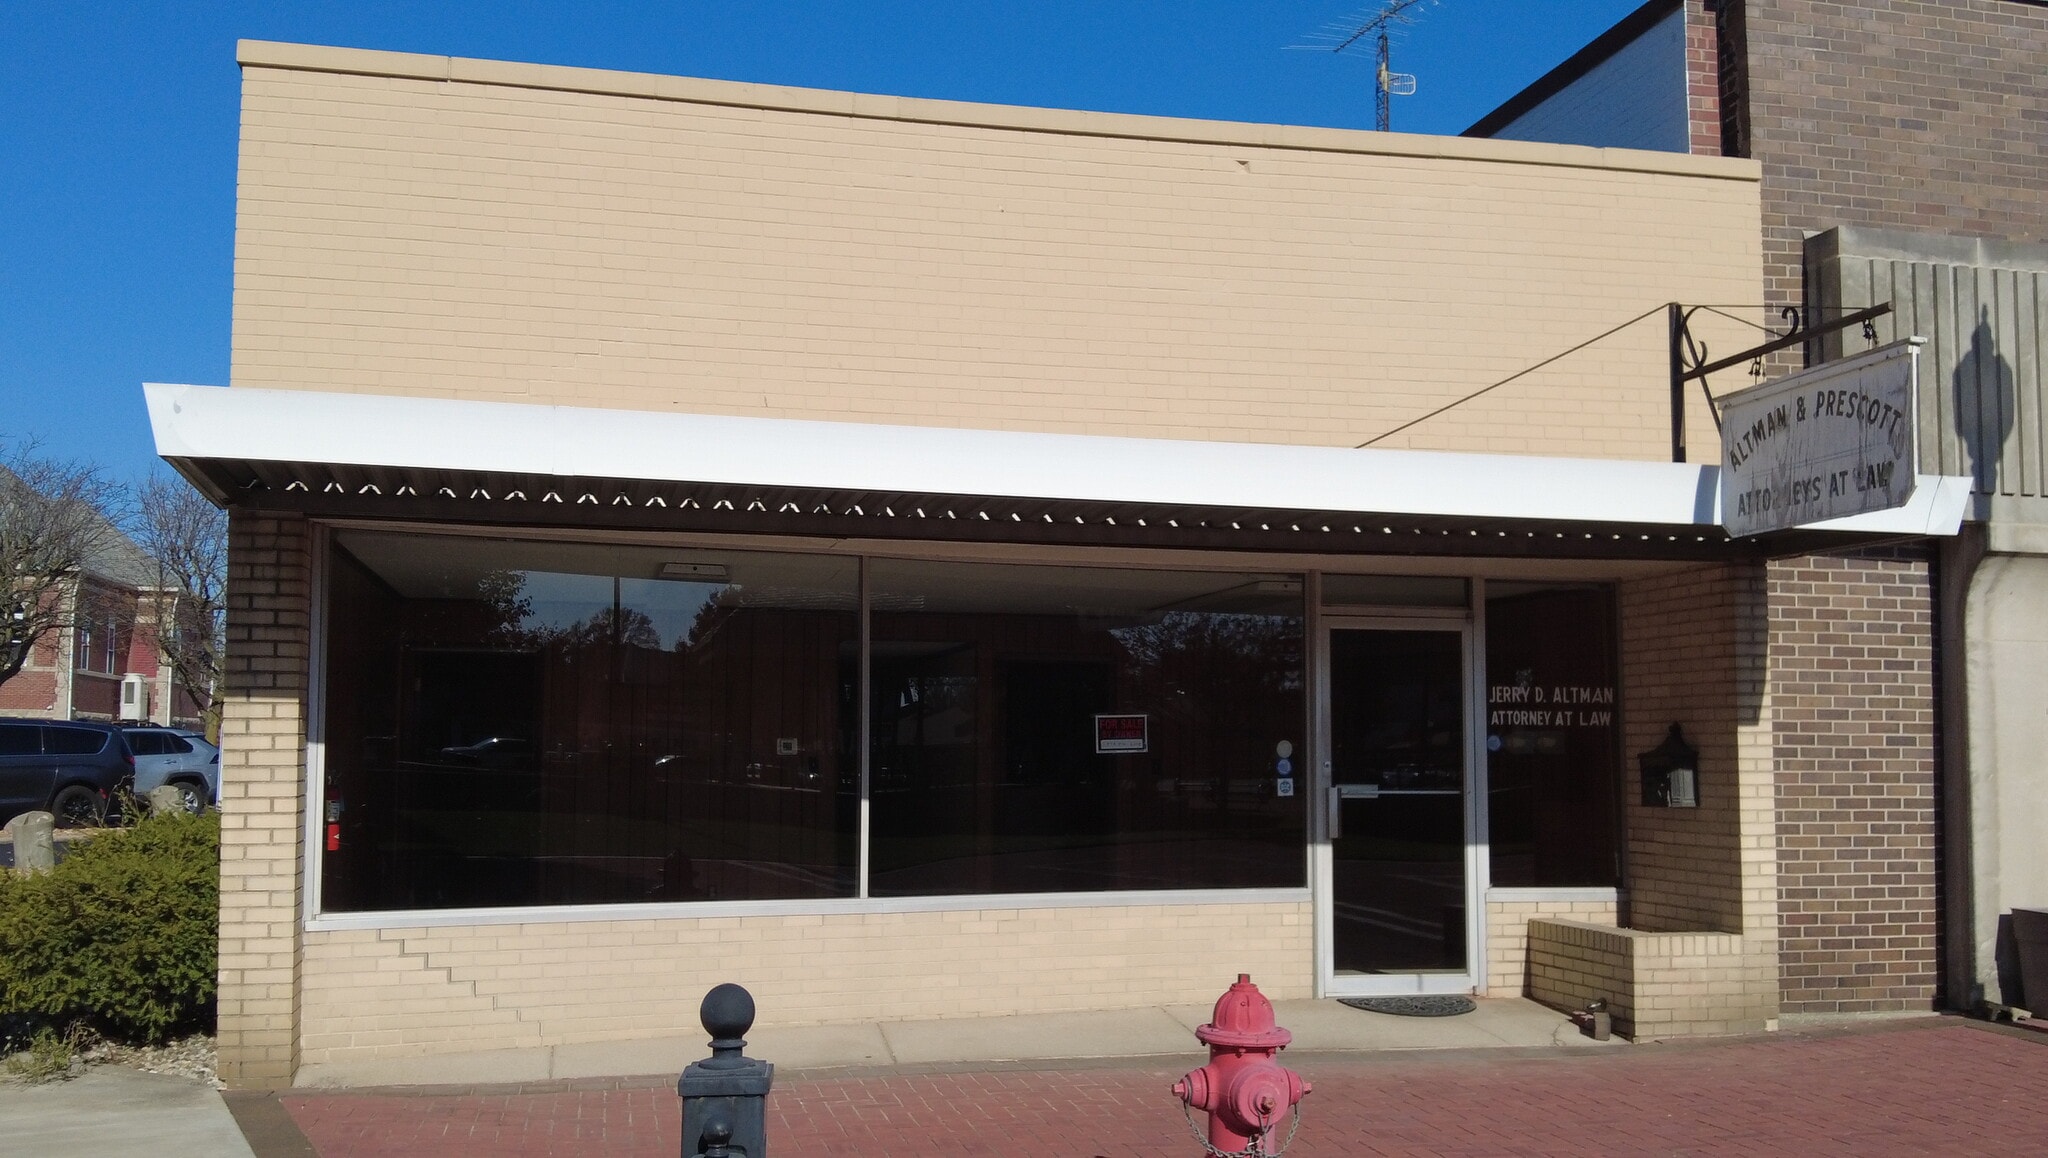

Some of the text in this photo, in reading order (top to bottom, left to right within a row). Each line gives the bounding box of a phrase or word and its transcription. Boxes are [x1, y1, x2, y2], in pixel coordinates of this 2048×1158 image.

[1730, 390, 1902, 472] ALTMAN & PRESCOTT
[1737, 476, 1821, 517] ATTOEYS
[1829, 471, 1849, 498] AT
[1489, 686, 1613, 703] JERRY D. ALTMAN
[1491, 710, 1612, 726] ATTORNEY AT LAW
